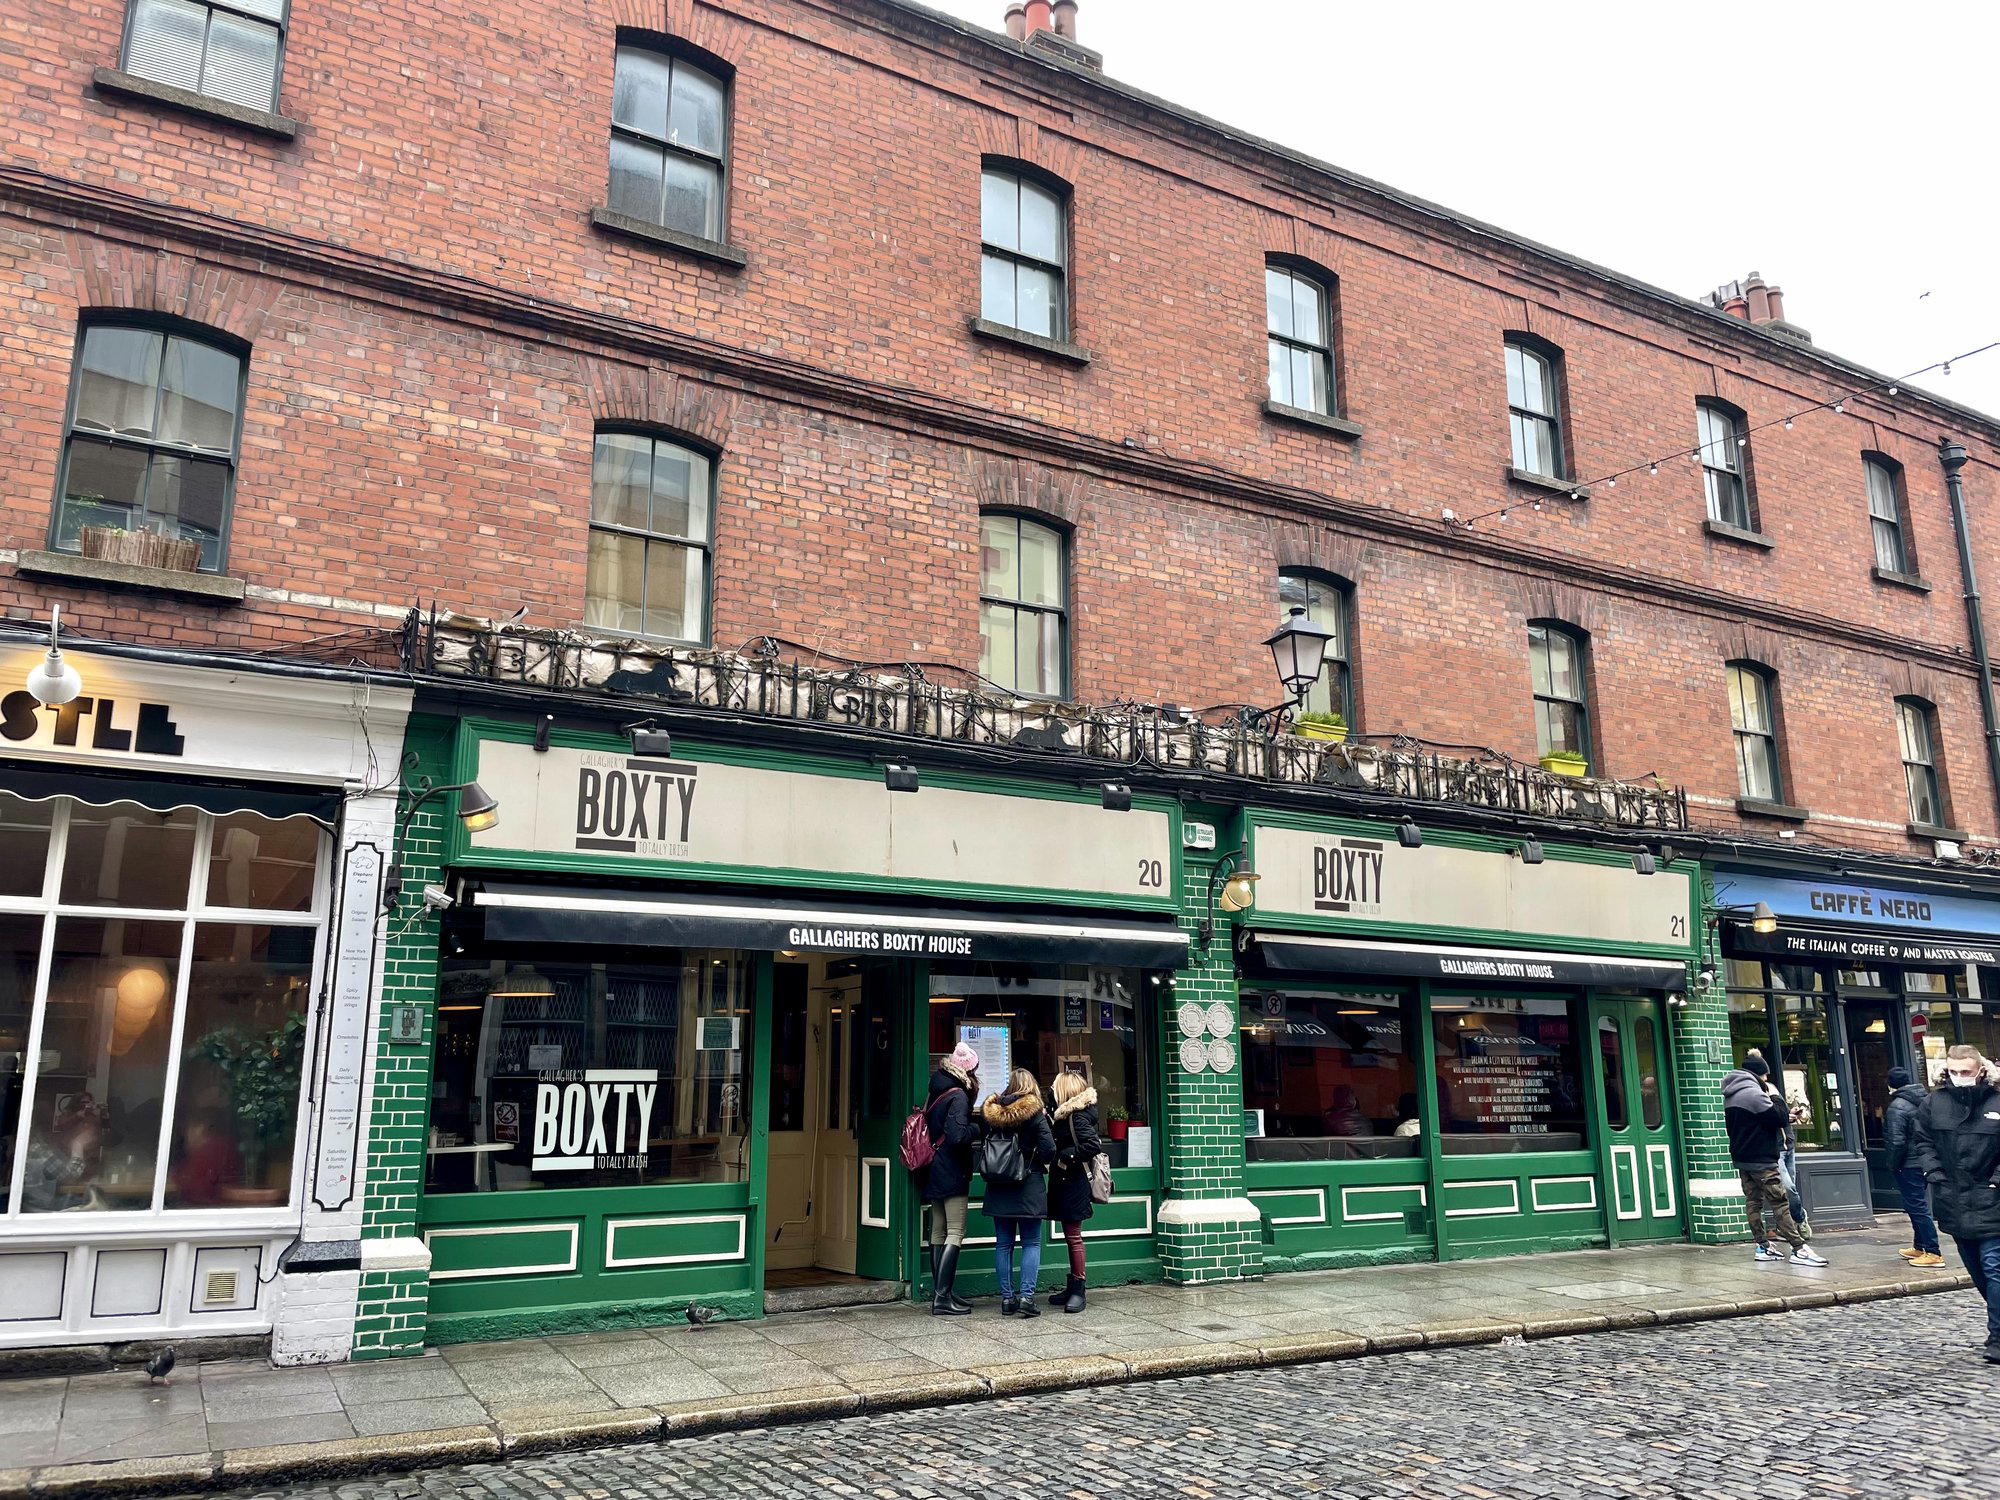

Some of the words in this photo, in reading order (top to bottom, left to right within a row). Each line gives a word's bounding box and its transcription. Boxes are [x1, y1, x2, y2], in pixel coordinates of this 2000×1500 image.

[580, 754, 625, 769] GALLAGHER'S
[576, 768, 697, 842] BOXTY
[639, 841, 667, 855] TOTALLY
[669, 842, 688, 857] IRISH
[1138, 859, 1162, 888] 20
[1314, 846, 1384, 904] BOXTY
[1810, 889, 1873, 915] CAFFÈ
[1879, 898, 1932, 921] NERO
[1671, 915, 1685, 938] 21
[789, 927, 880, 950] GALLAGHERS
[883, 933, 925, 952] BOXTY
[928, 936, 972, 954] HOUSE
[1787, 936, 1805, 950] THE
[1809, 939, 1847, 954] ITALIAN
[1851, 942, 1885, 957] COFFEE
[1903, 947, 1921, 959] AND
[1923, 947, 1959, 960] MASTER
[1957, 949, 1996, 963] ROASTERS
[1440, 959, 1497, 976] GALLAGHERS
[1497, 963, 1525, 977] BOXTY
[1526, 964, 1555, 979] HOUSE
[538, 1069, 585, 1082] GALLAGHER'S
[533, 1083, 658, 1155] BOXTY
[597, 1155, 627, 1169] TOTALLY
[627, 1155, 648, 1169] IRISH
